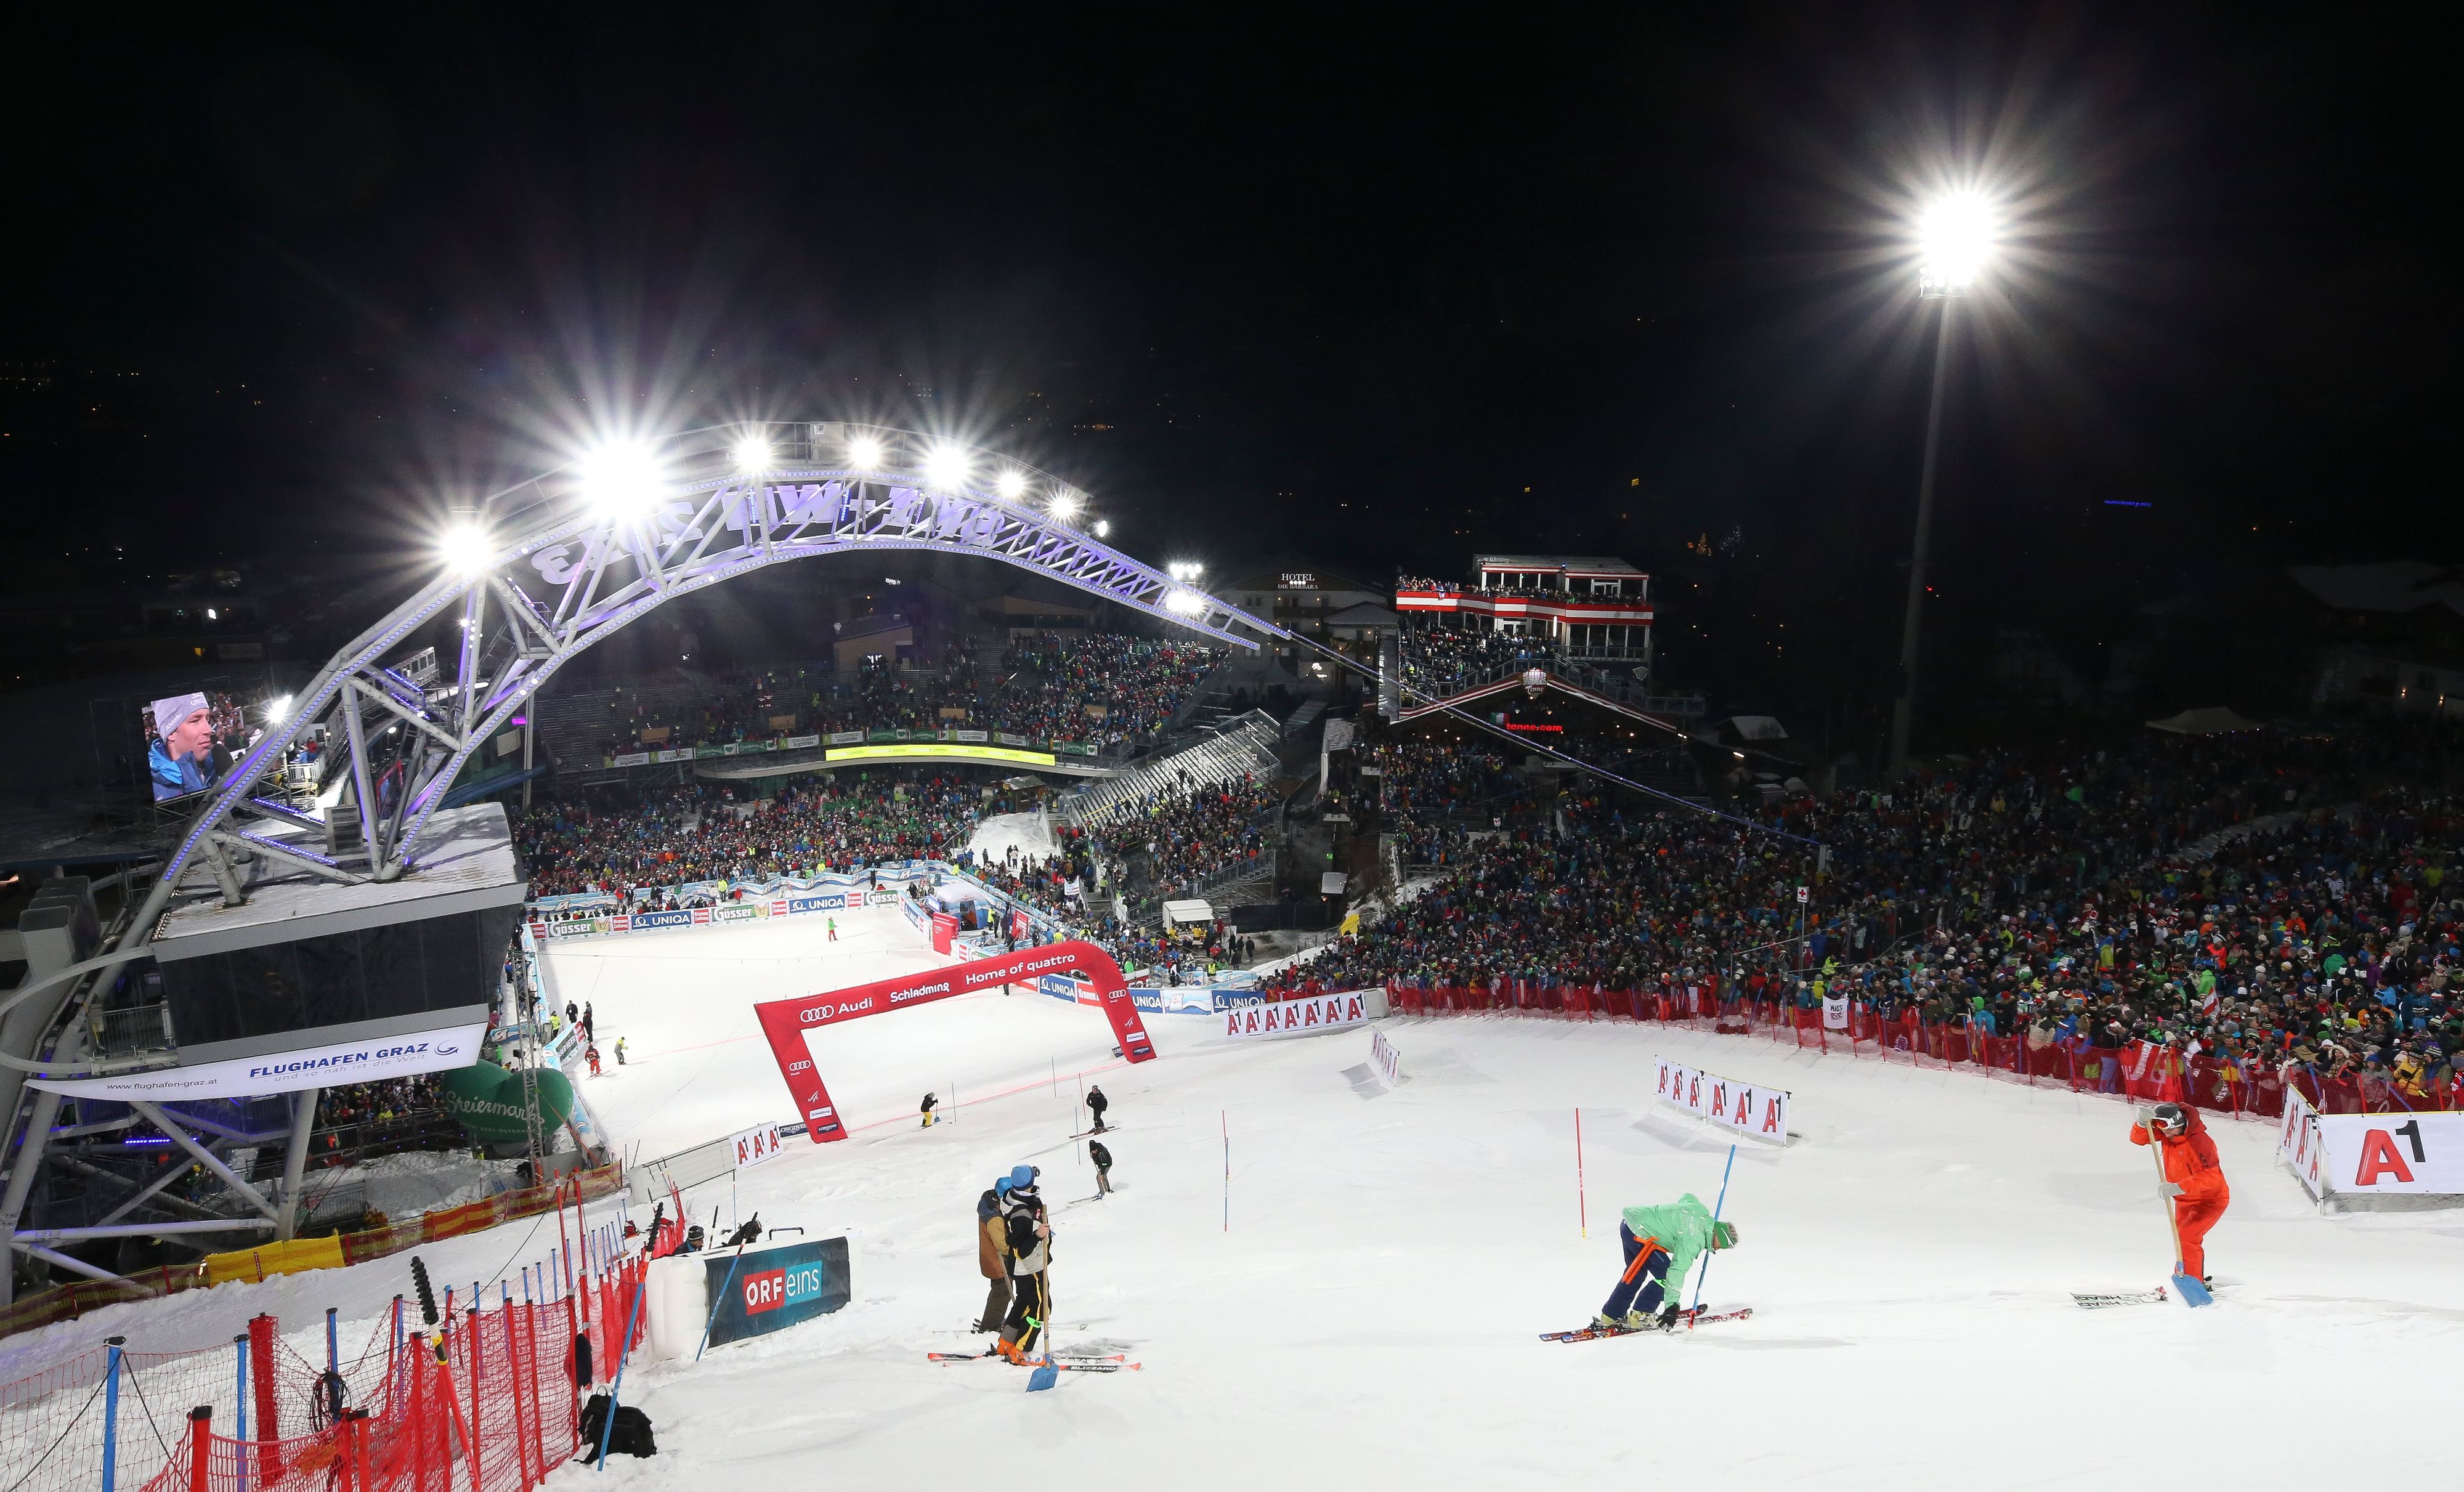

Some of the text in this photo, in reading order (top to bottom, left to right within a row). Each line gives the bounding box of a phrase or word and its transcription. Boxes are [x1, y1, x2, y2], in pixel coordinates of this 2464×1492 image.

[1507, 723, 1562, 731] tenne.com
[809, 897, 844, 910] UNIQA
[866, 891, 898, 906] Gösse
[652, 914, 690, 925] UNIQA
[713, 907, 752, 922] Gösser
[549, 922, 591, 937] Gösser
[838, 997, 873, 1015] Audi
[890, 982, 950, 1003] Schladming
[966, 969, 1006, 985] Home
[1009, 962, 1024, 975] of
[1027, 954, 1076, 972] quattro
[1051, 982, 1076, 998] UNIQA
[1078, 987, 1096, 1001] Kronen
[1132, 995, 1162, 1008] UNIQA
[1227, 993, 1364, 1036] A1 A1 A1 A1 A1 A1 A1
[250, 1043, 429, 1077] FLUGHAFEN GRAZ
[275, 1073, 298, 1082] und
[397, 1054, 429, 1063] Welt.
[107, 1079, 217, 1090] www.flughafen-graz.at
[1658, 1063, 1781, 1133] A1 A1 A1 A1 A1 A1
[446, 1091, 545, 1124] Steiermark
[738, 1125, 780, 1165] A1 A1 A1
[2355, 1120, 2426, 1186] A1
[746, 1269, 819, 1307] ORF eins
